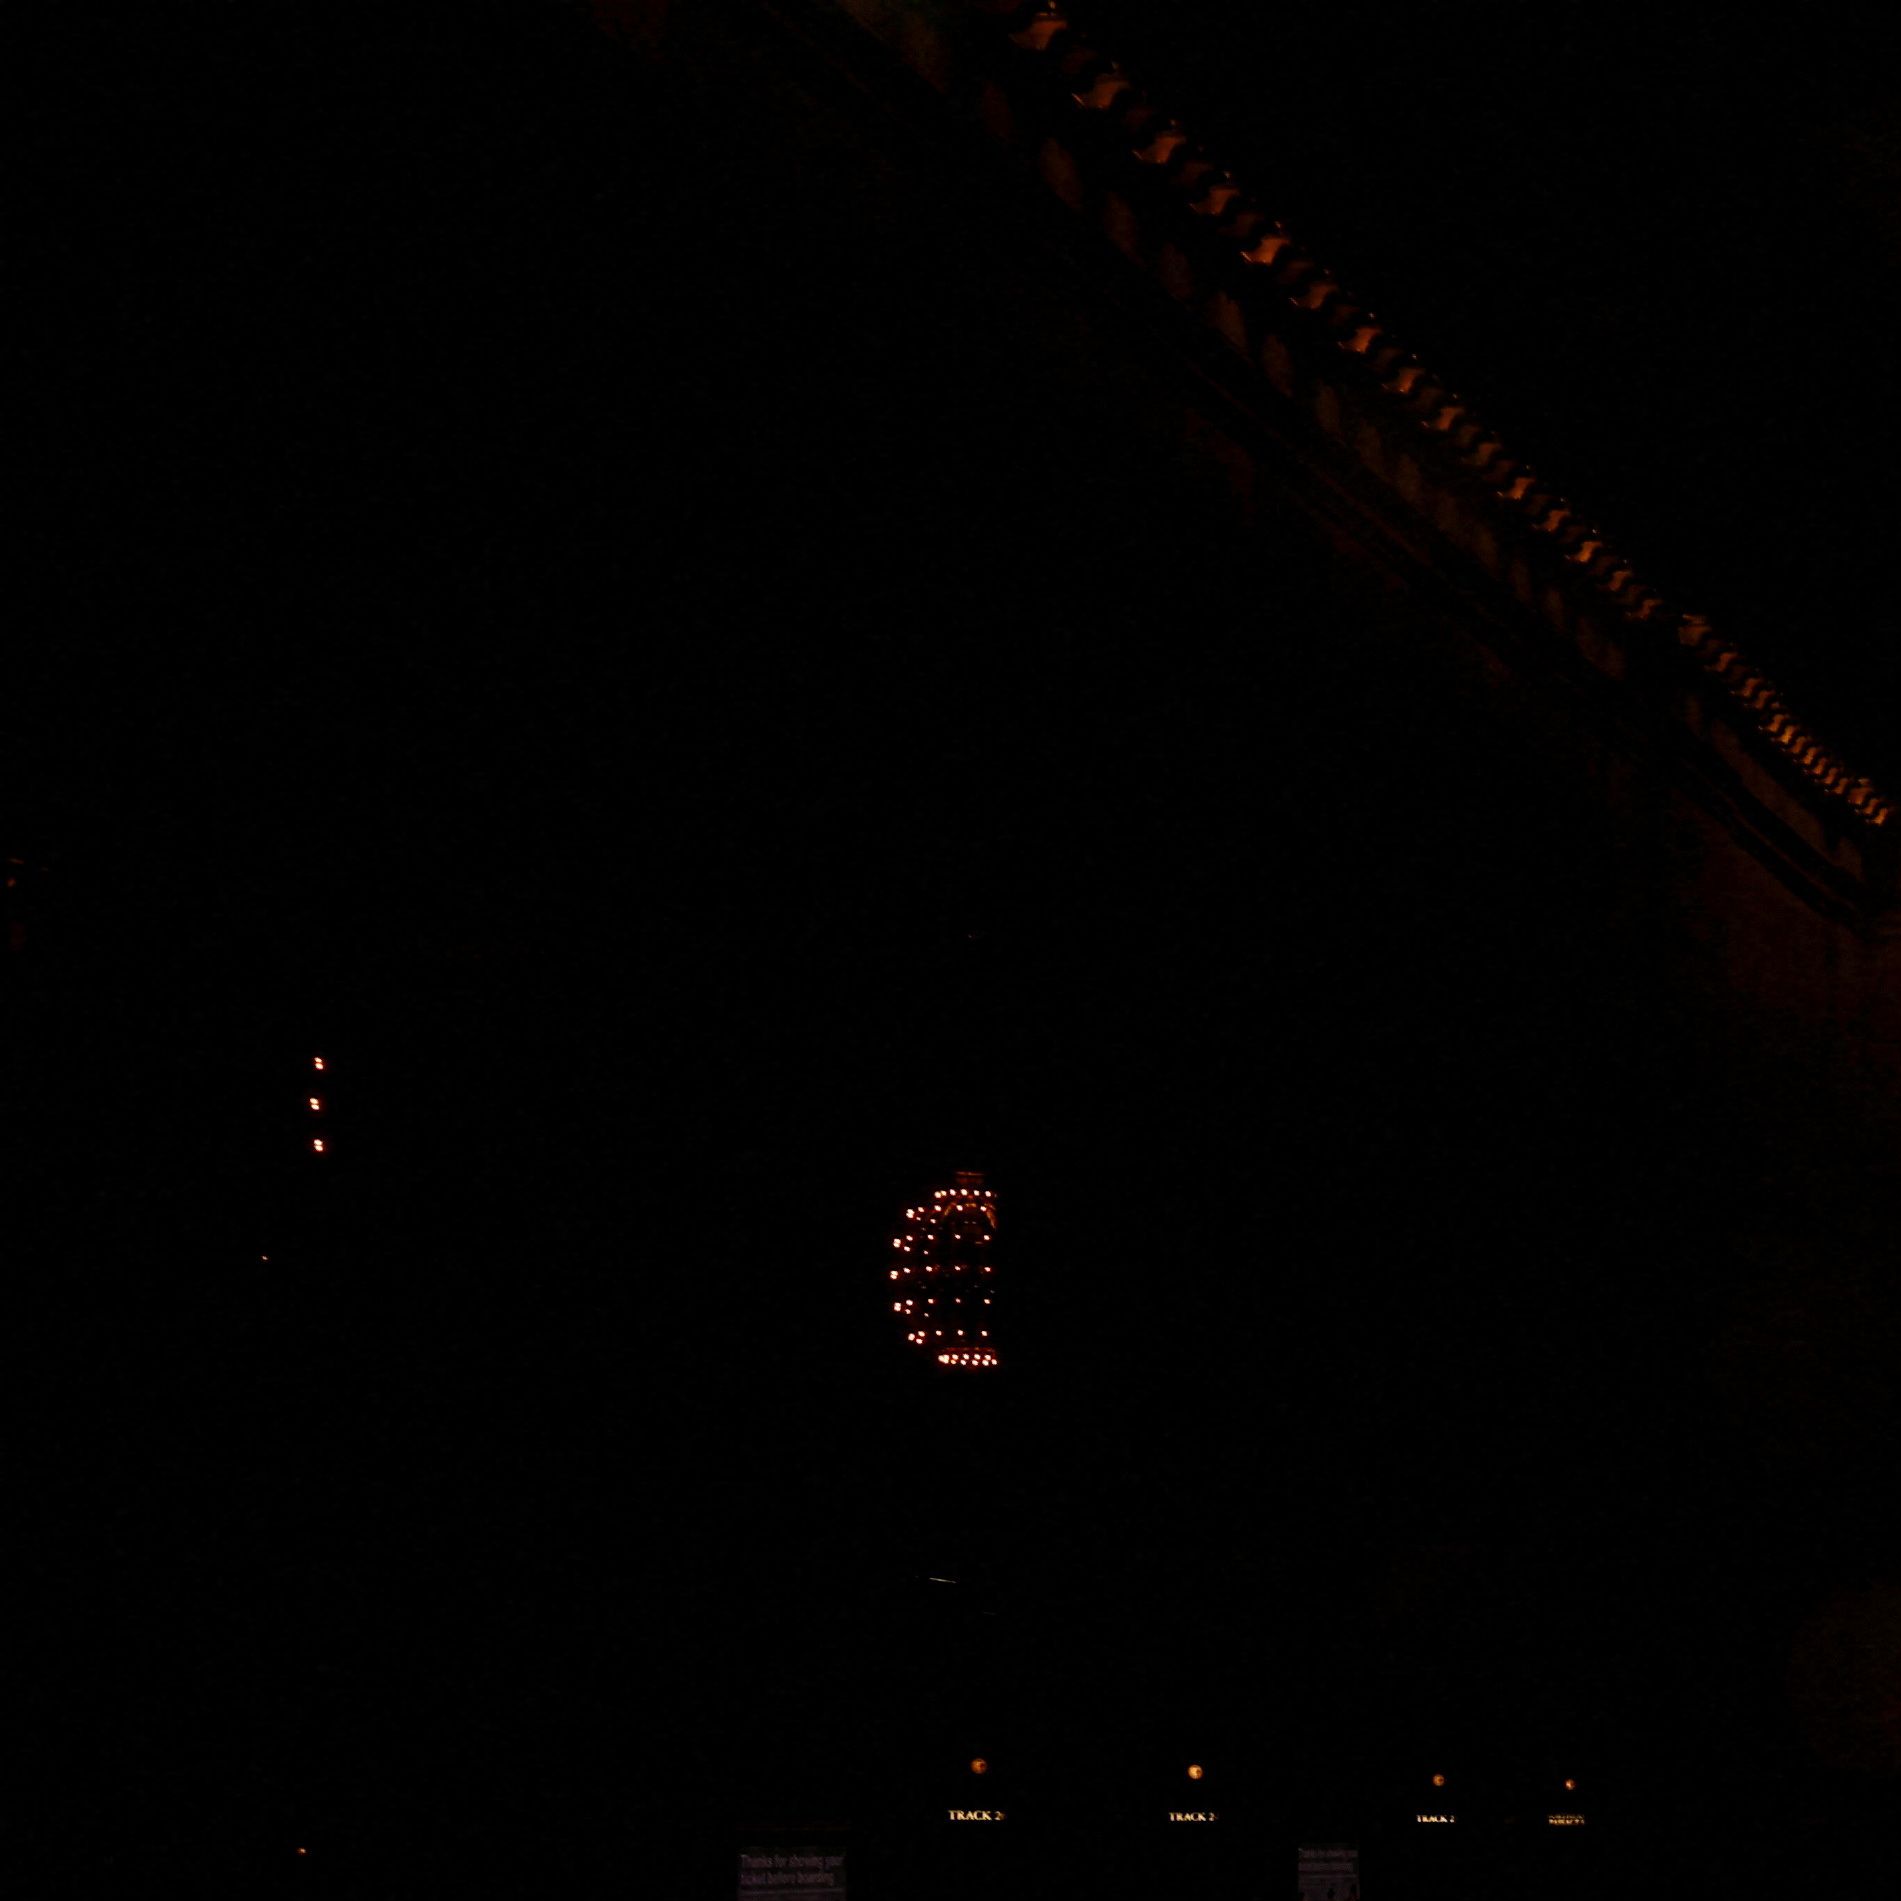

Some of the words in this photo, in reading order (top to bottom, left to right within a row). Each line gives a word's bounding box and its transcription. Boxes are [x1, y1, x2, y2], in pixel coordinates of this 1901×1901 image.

[948, 1810, 992, 1821] TRACK
[1168, 1812, 1207, 1822] TRACK
[1416, 1814, 1448, 1823] TRACK
